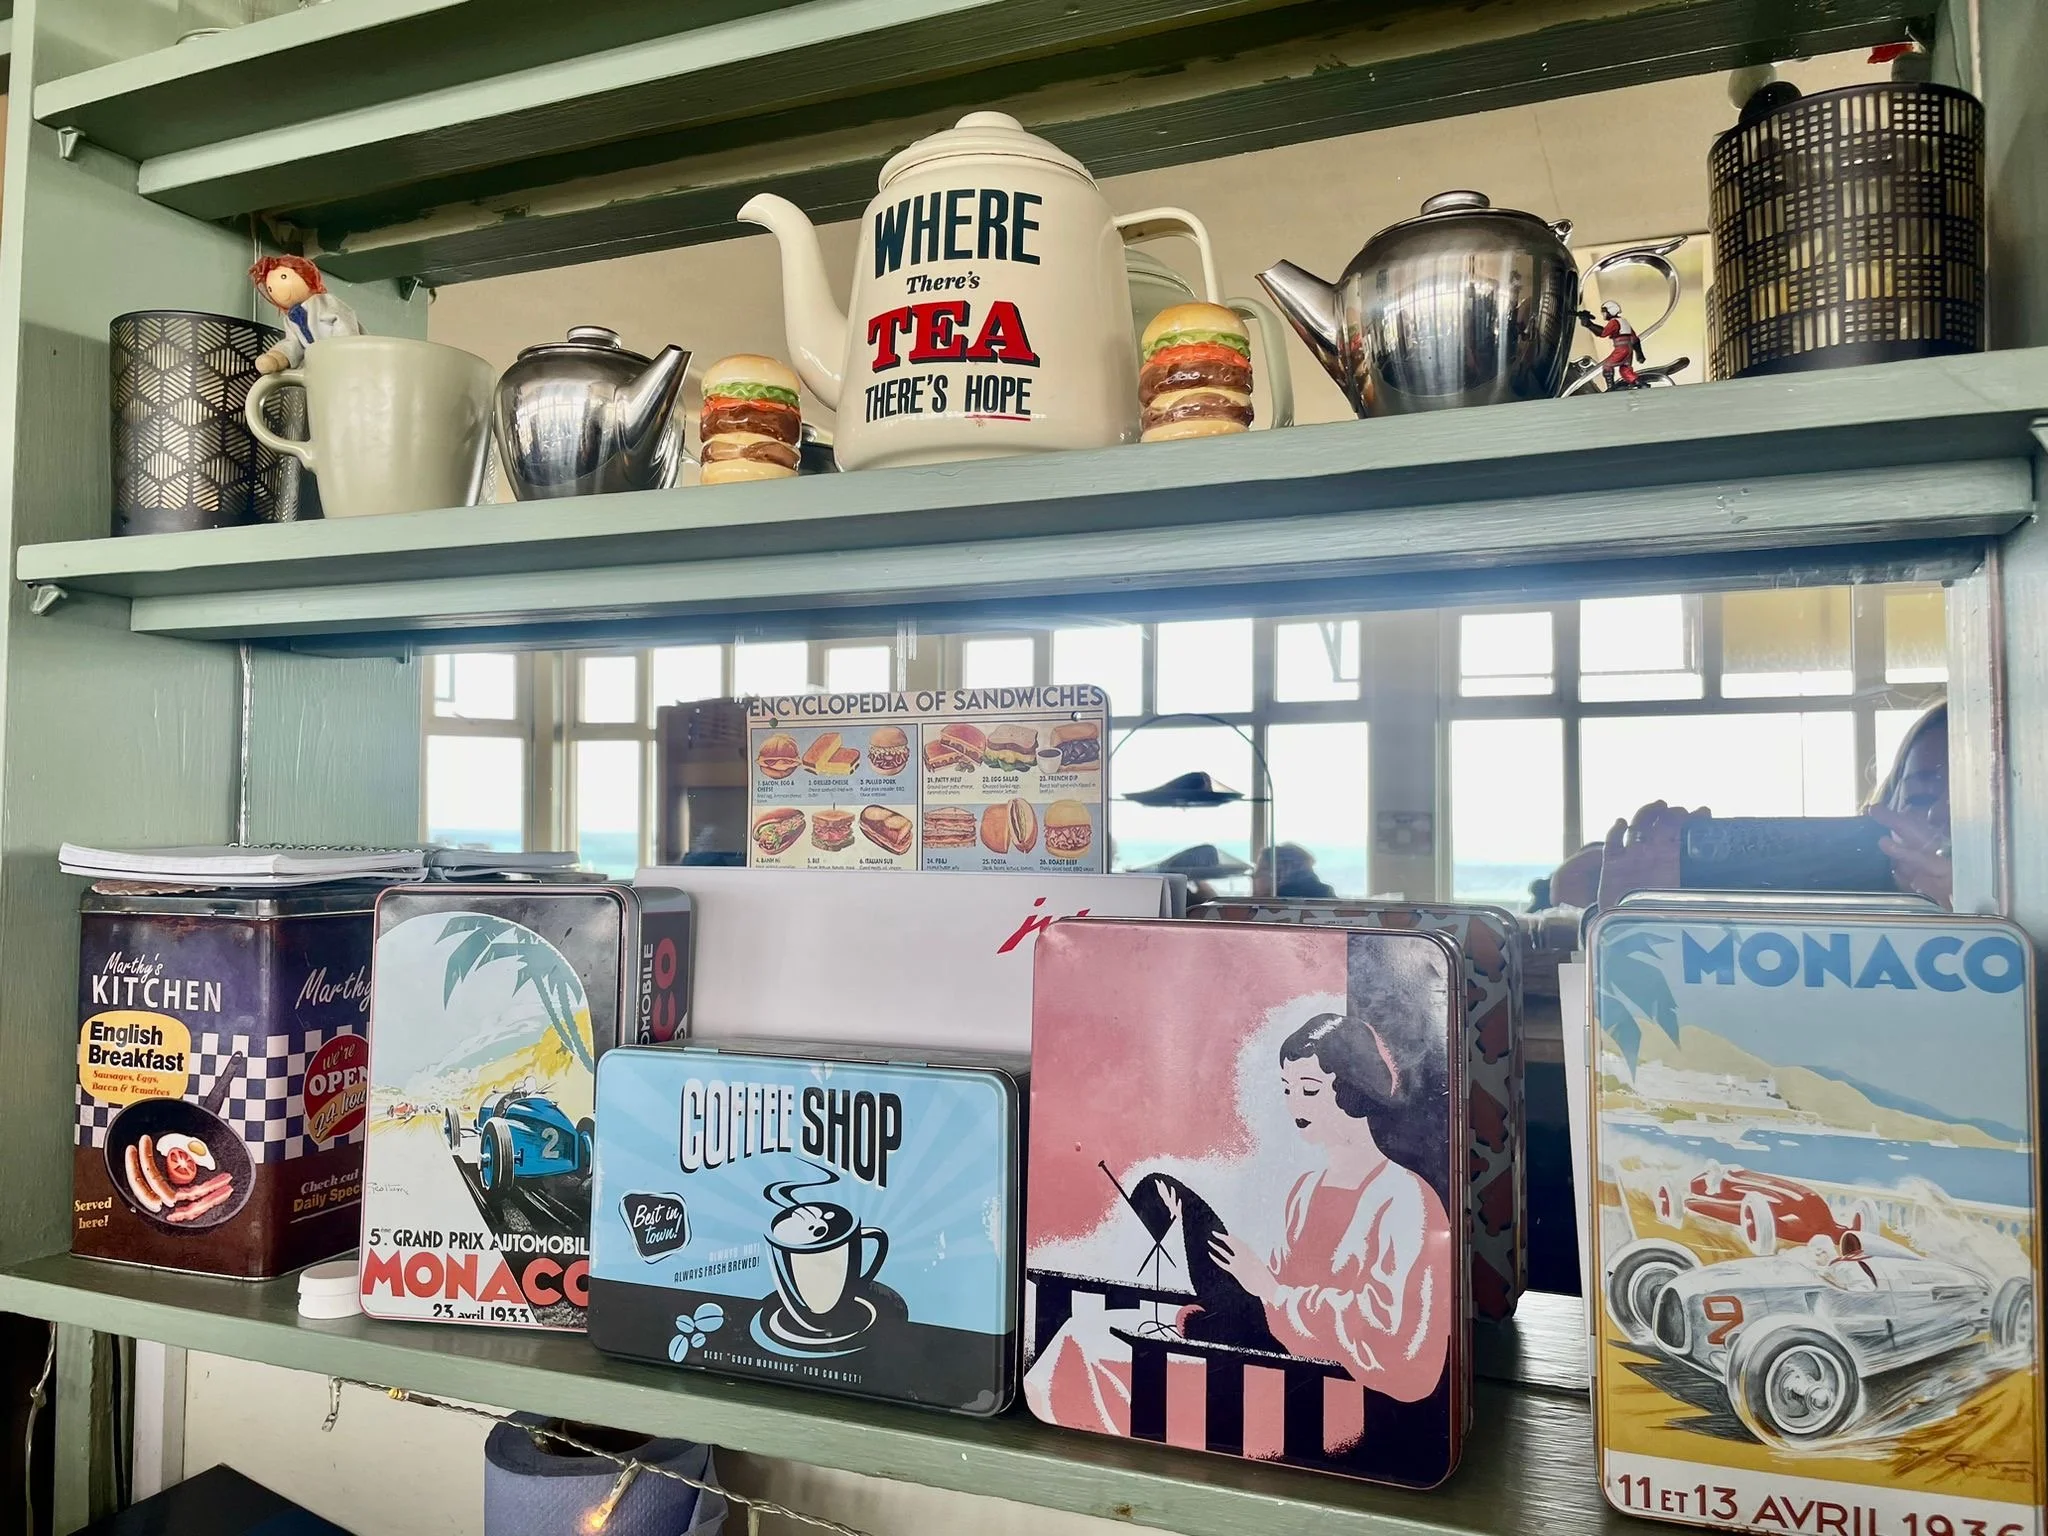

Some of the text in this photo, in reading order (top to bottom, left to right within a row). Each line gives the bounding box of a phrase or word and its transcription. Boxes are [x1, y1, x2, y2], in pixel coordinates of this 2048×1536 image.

[874, 188, 1042, 280] WHERE
[906, 271, 981, 294] There's
[867, 300, 1041, 373] TEA
[865, 374, 1032, 423] THERE'S HOPE
[750, 685, 1104, 718] ENCYCLOPEDIA OF SANDWICHES
[103, 951, 163, 983] Marthy's
[1681, 929, 2023, 994] MONACO
[92, 975, 221, 1012] KITCHEN
[294, 965, 372, 1012] Marthy
[640, 943, 654, 1045] OMOBILE
[90, 1021, 163, 1047] English
[88, 1044, 184, 1072] Breakfast
[322, 1042, 355, 1071] we're
[92, 1070, 134, 1081] Sausages,
[92, 1082, 118, 1092] Bacon
[130, 1085, 170, 1096] Tomatoes
[340, 1089, 367, 1116] hou
[315, 1103, 338, 1137] 24
[680, 1078, 902, 1191] COFFEE SHOP
[541, 1127, 559, 1159] 2
[293, 1192, 327, 1212] Daily
[329, 1184, 361, 1202] Spec
[300, 1174, 338, 1195] Check
[74, 1196, 112, 1212] Served
[633, 1203, 680, 1228] Best in
[78, 1215, 109, 1229] here!
[645, 1213, 682, 1244] town!
[393, 1230, 443, 1248] GRAND
[450, 1231, 485, 1250] PRIX
[490, 1233, 589, 1256] AUTOMOBIL
[674, 1256, 760, 1282] ALWAYS FRESH BREWED!
[433, 1303, 454, 1318] 23
[490, 1307, 530, 1323] 1933
[1702, 1295, 1744, 1344] 9
[703, 1350, 723, 1360] BEST
[803, 1366, 819, 1376] YOU
[823, 1369, 838, 1380] CAN
[843, 1372, 862, 1384] GET!
[1618, 1474, 1652, 1509] 11
[1661, 1488, 1688, 1513] ET
[1693, 1484, 1738, 1520] 13
[1752, 1494, 1887, 1536] AVRIL
